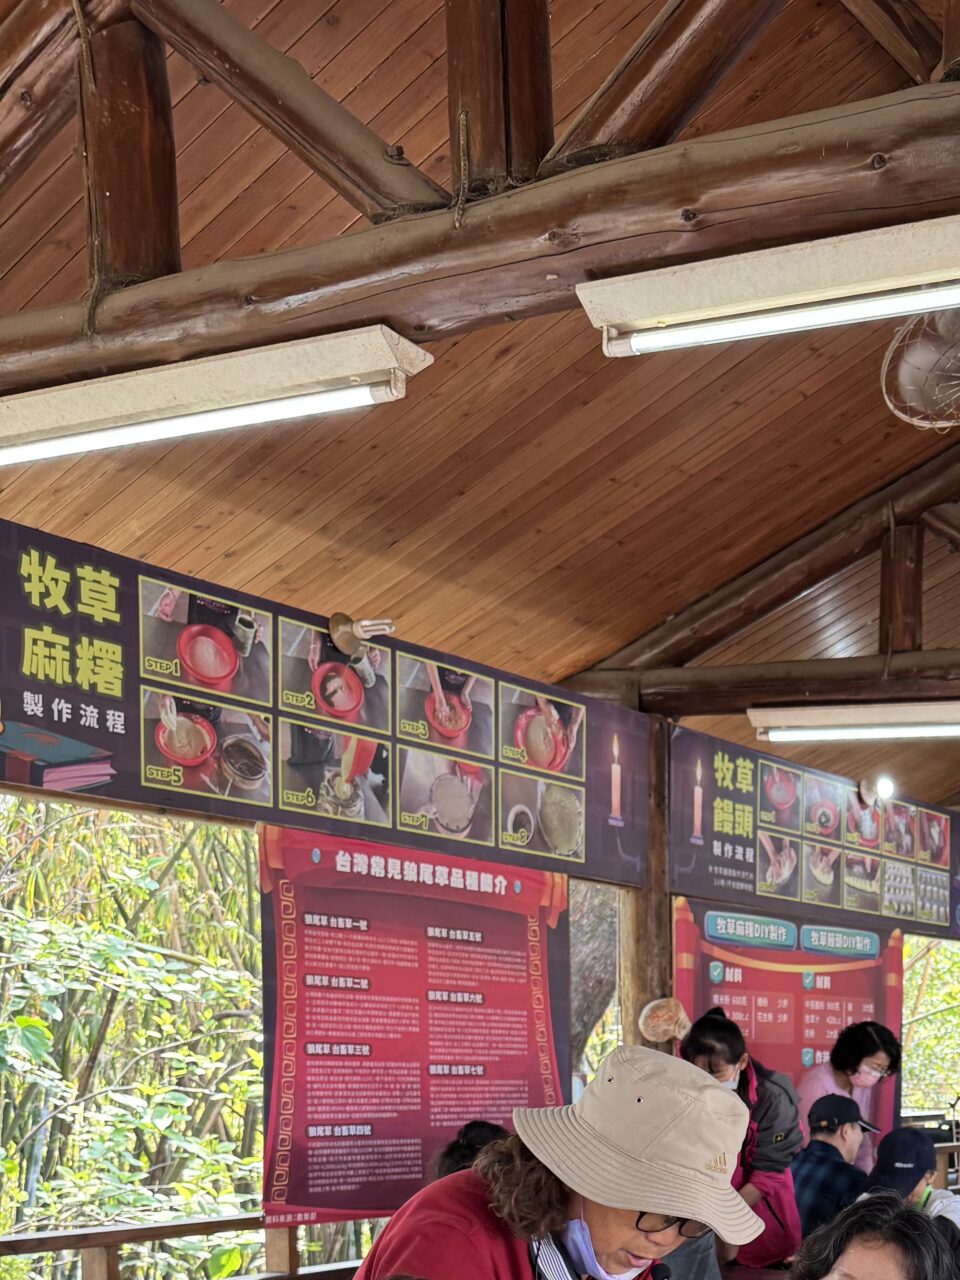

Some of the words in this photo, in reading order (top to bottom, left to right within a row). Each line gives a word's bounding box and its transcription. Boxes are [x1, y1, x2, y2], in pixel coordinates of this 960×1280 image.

[20, 548, 120, 623] 牧草
[22, 625, 124, 698] 麻糬
[146, 658, 181, 676] STEP1
[283, 691, 315, 708] STEP2
[23, 691, 126, 734] 製作流程
[401, 720, 429, 739] STEP3
[503, 746, 529, 763] STEP4
[146, 767, 183, 785] STEP5
[713, 750, 754, 794] 牧草
[284, 790, 316, 806] STEP6
[401, 812, 429, 829] STEP7
[712, 796, 754, 839] 饅頭
[503, 828, 529, 845] STEP8
[712, 840, 754, 863] 製作流程
[335, 850, 507, 896] 台灣常見狼尾草品種簡介
